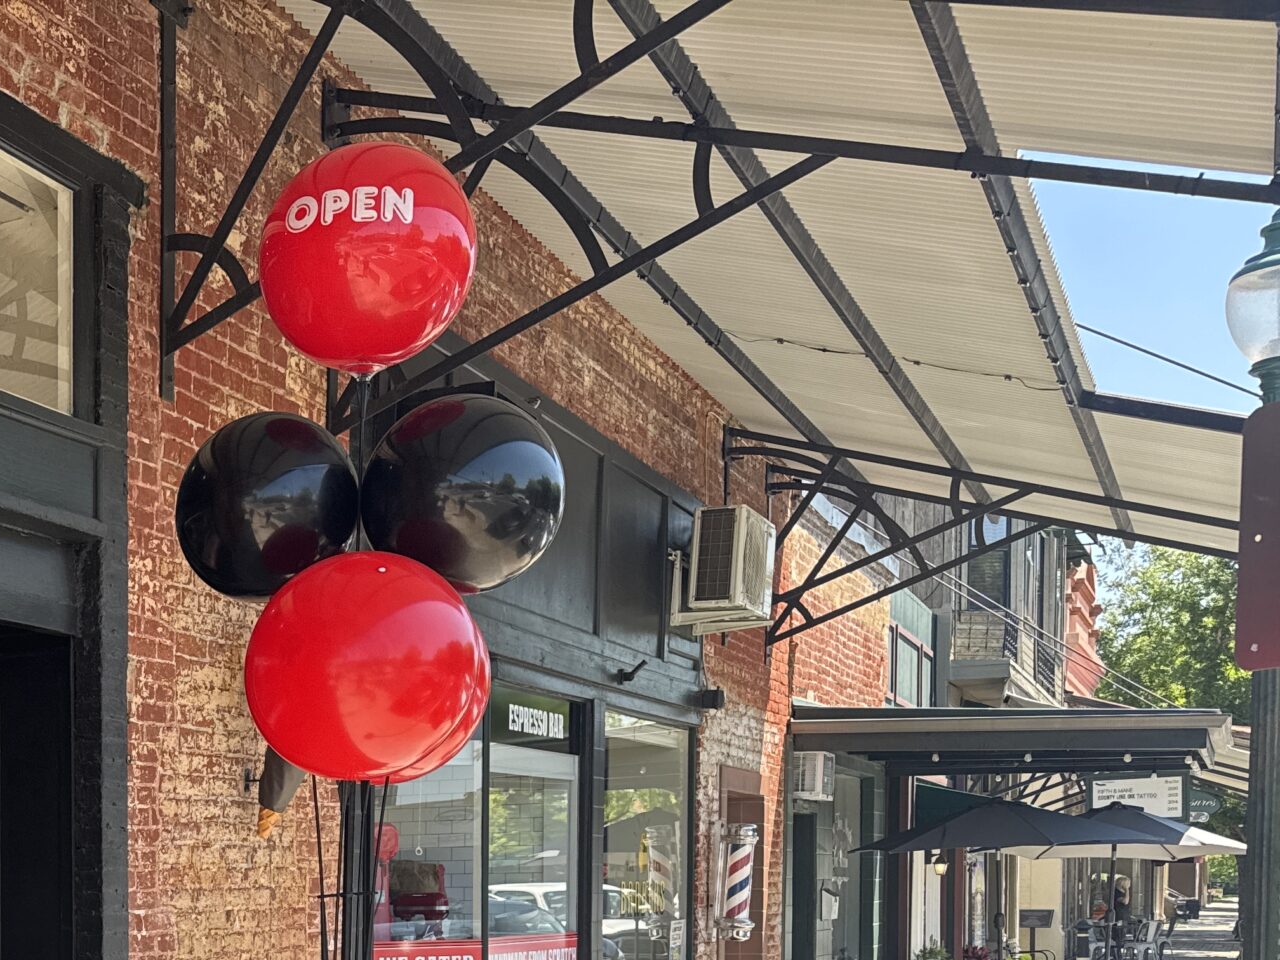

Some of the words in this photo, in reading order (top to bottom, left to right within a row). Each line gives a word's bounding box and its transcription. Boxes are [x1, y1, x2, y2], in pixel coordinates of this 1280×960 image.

[285, 185, 415, 233] OPEN
[508, 703, 548, 737] ESPRESSO
[548, 711, 564, 739] BAR
